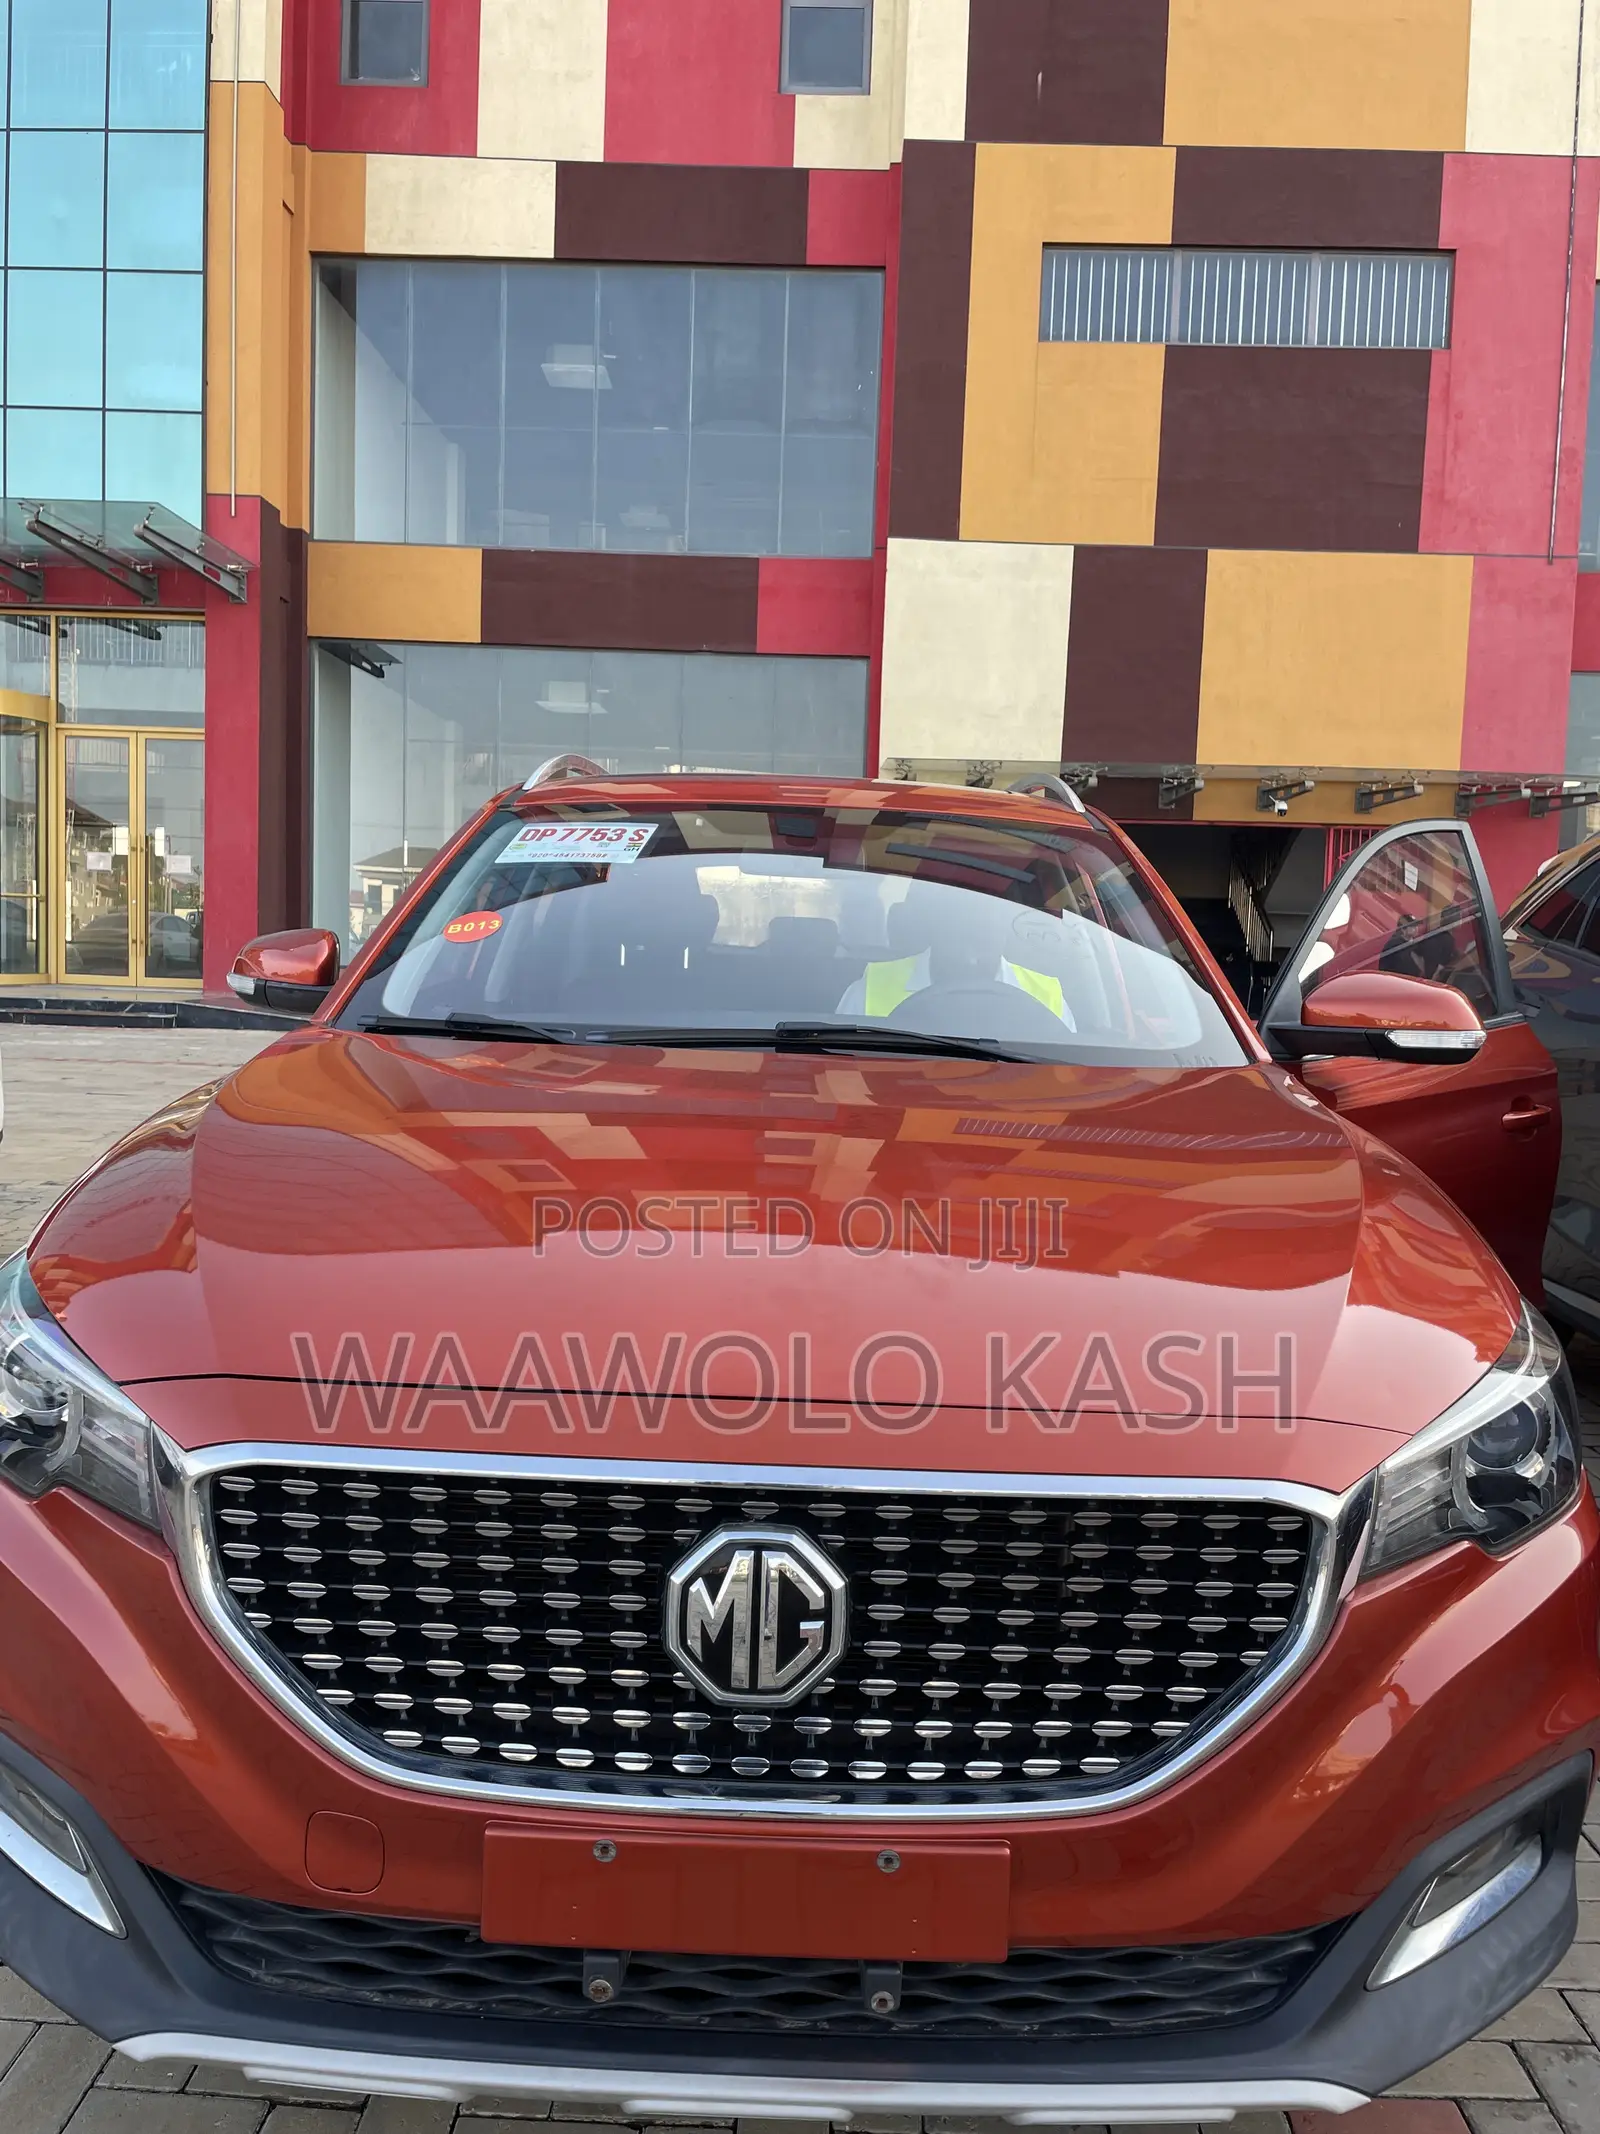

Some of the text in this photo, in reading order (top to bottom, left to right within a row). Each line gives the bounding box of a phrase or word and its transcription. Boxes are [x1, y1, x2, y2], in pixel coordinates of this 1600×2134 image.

[518, 828, 649, 842] DP 7753 S
[447, 919, 501, 934] B013
[687, 1550, 825, 1690] MG
